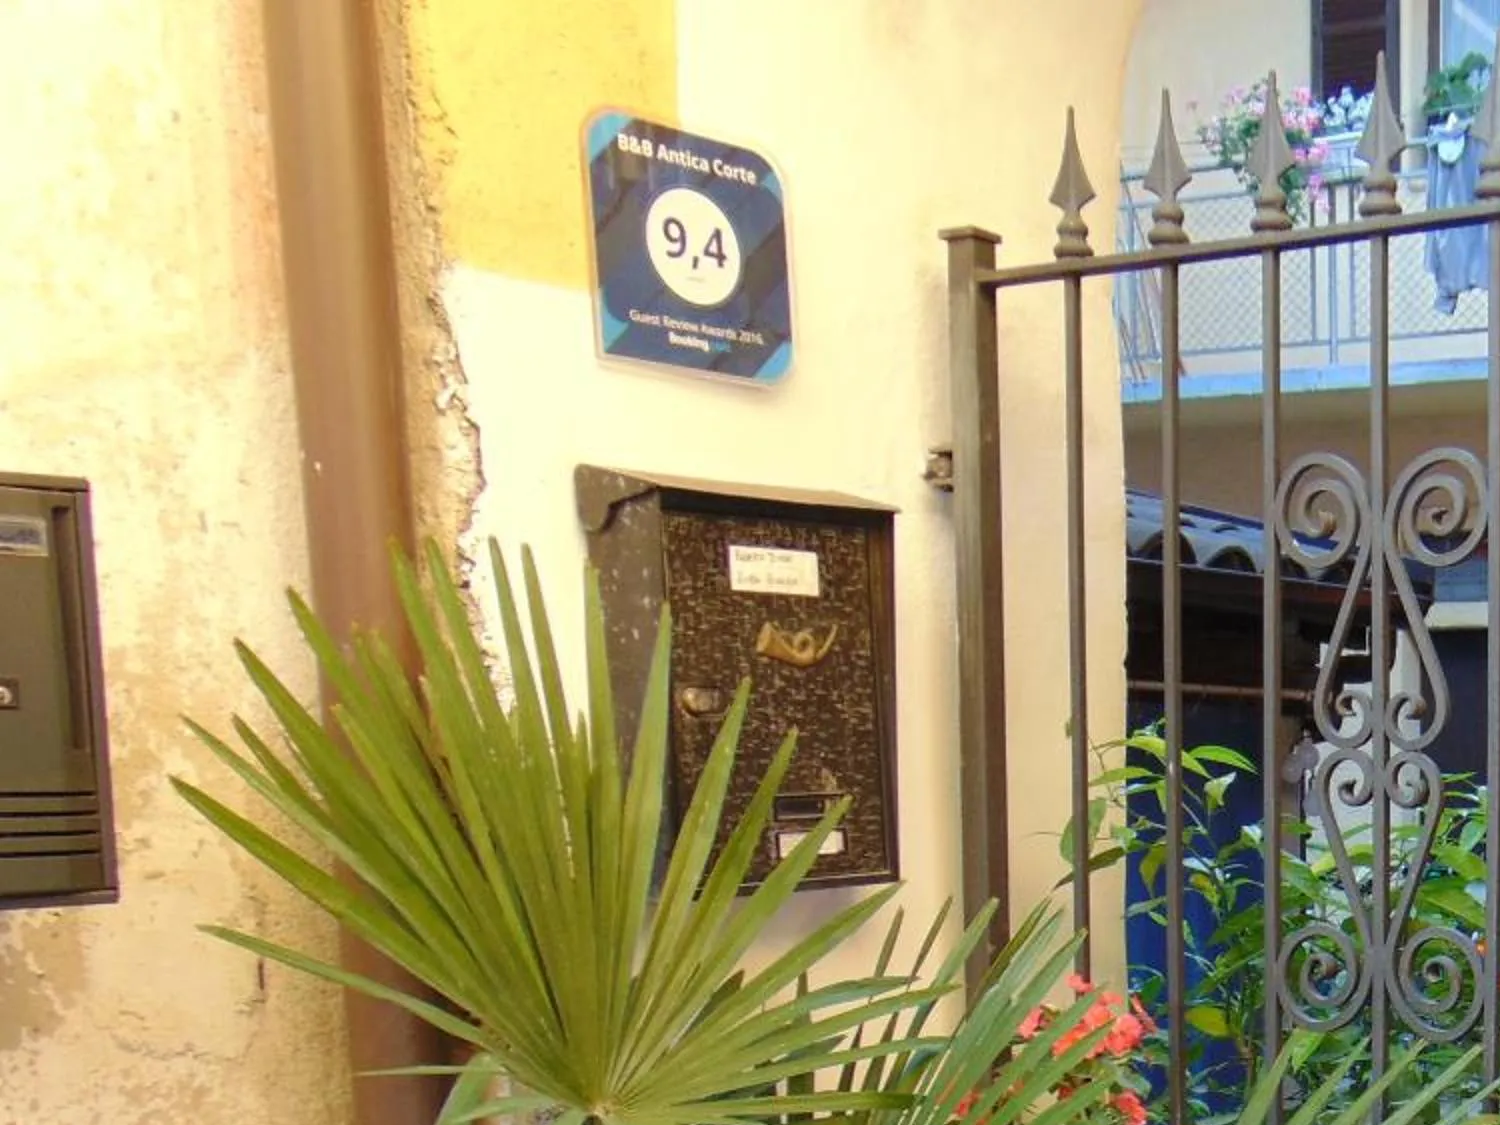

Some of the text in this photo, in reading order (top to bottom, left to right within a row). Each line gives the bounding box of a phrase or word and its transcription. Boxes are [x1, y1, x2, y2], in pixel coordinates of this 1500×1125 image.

[617, 133, 757, 185] B&B Antica Corte
[662, 217, 727, 269] 9,4
